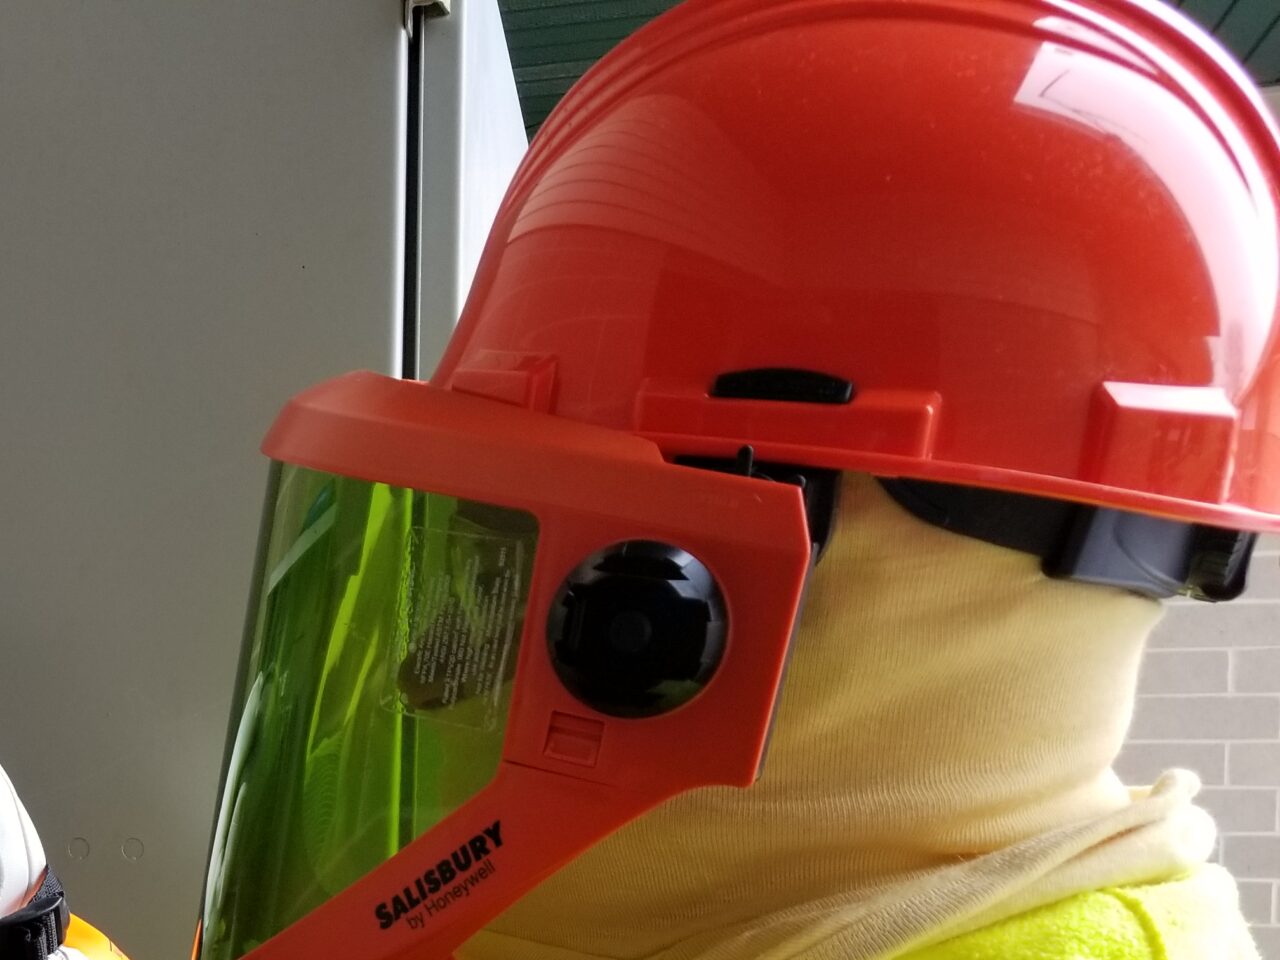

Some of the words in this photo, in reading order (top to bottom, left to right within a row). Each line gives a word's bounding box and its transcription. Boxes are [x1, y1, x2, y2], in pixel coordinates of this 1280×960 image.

[375, 819, 503, 929] SALISBURY
[406, 910, 425, 930] by
[425, 858, 496, 917] Honeywell
